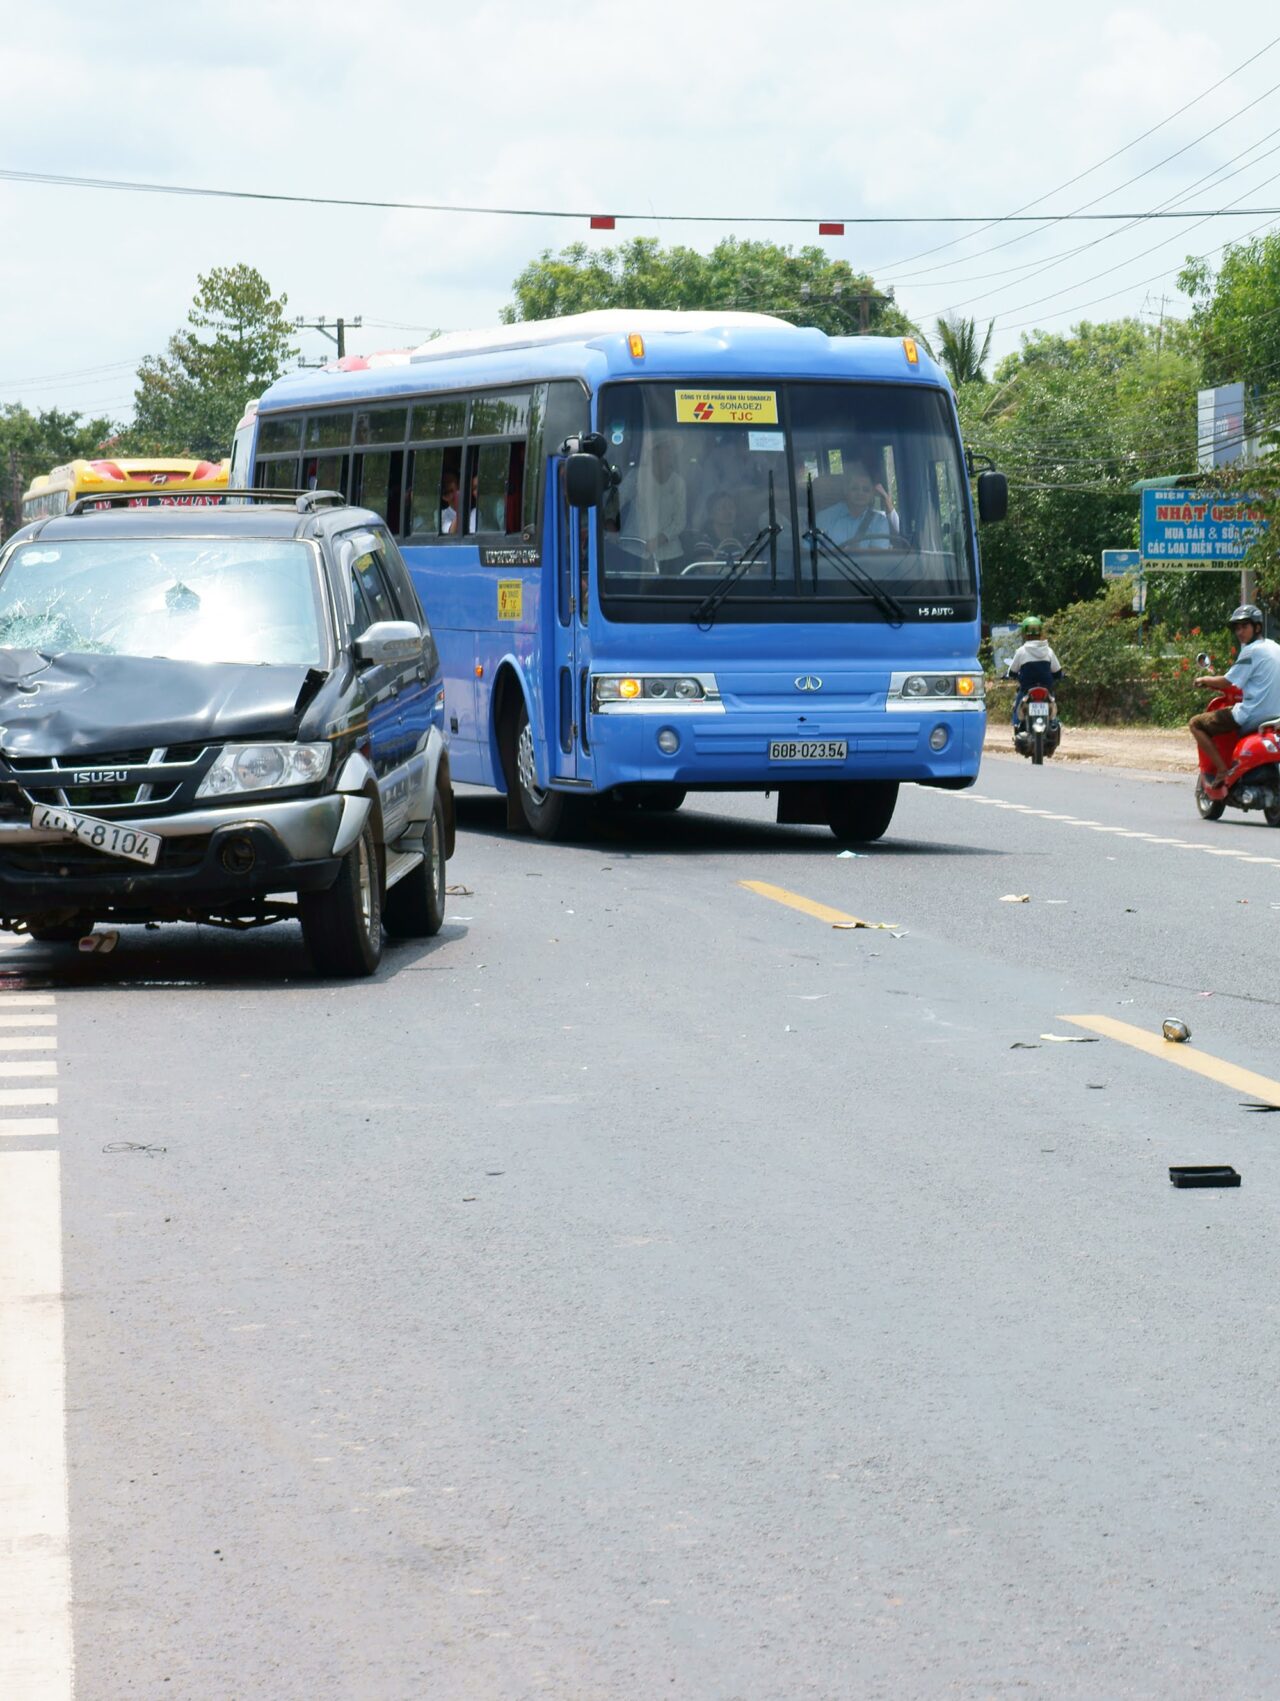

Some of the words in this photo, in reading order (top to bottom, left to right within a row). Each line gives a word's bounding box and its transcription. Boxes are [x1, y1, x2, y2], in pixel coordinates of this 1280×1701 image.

[720, 403, 762, 411] SONADEZI
[730, 412, 753, 421] TJC
[1156, 502, 1206, 525] NHẬT
[1165, 527, 1184, 539] MUA
[1186, 524, 1205, 539] BÁN
[1208, 527, 1218, 539] &
[1147, 540, 1165, 554] CÁC
[1167, 542, 1189, 556] LOẠI
[931, 607, 954, 616] AUTO
[772, 743, 845, 758] 60B-023.54
[73, 771, 128, 784] ISUZU
